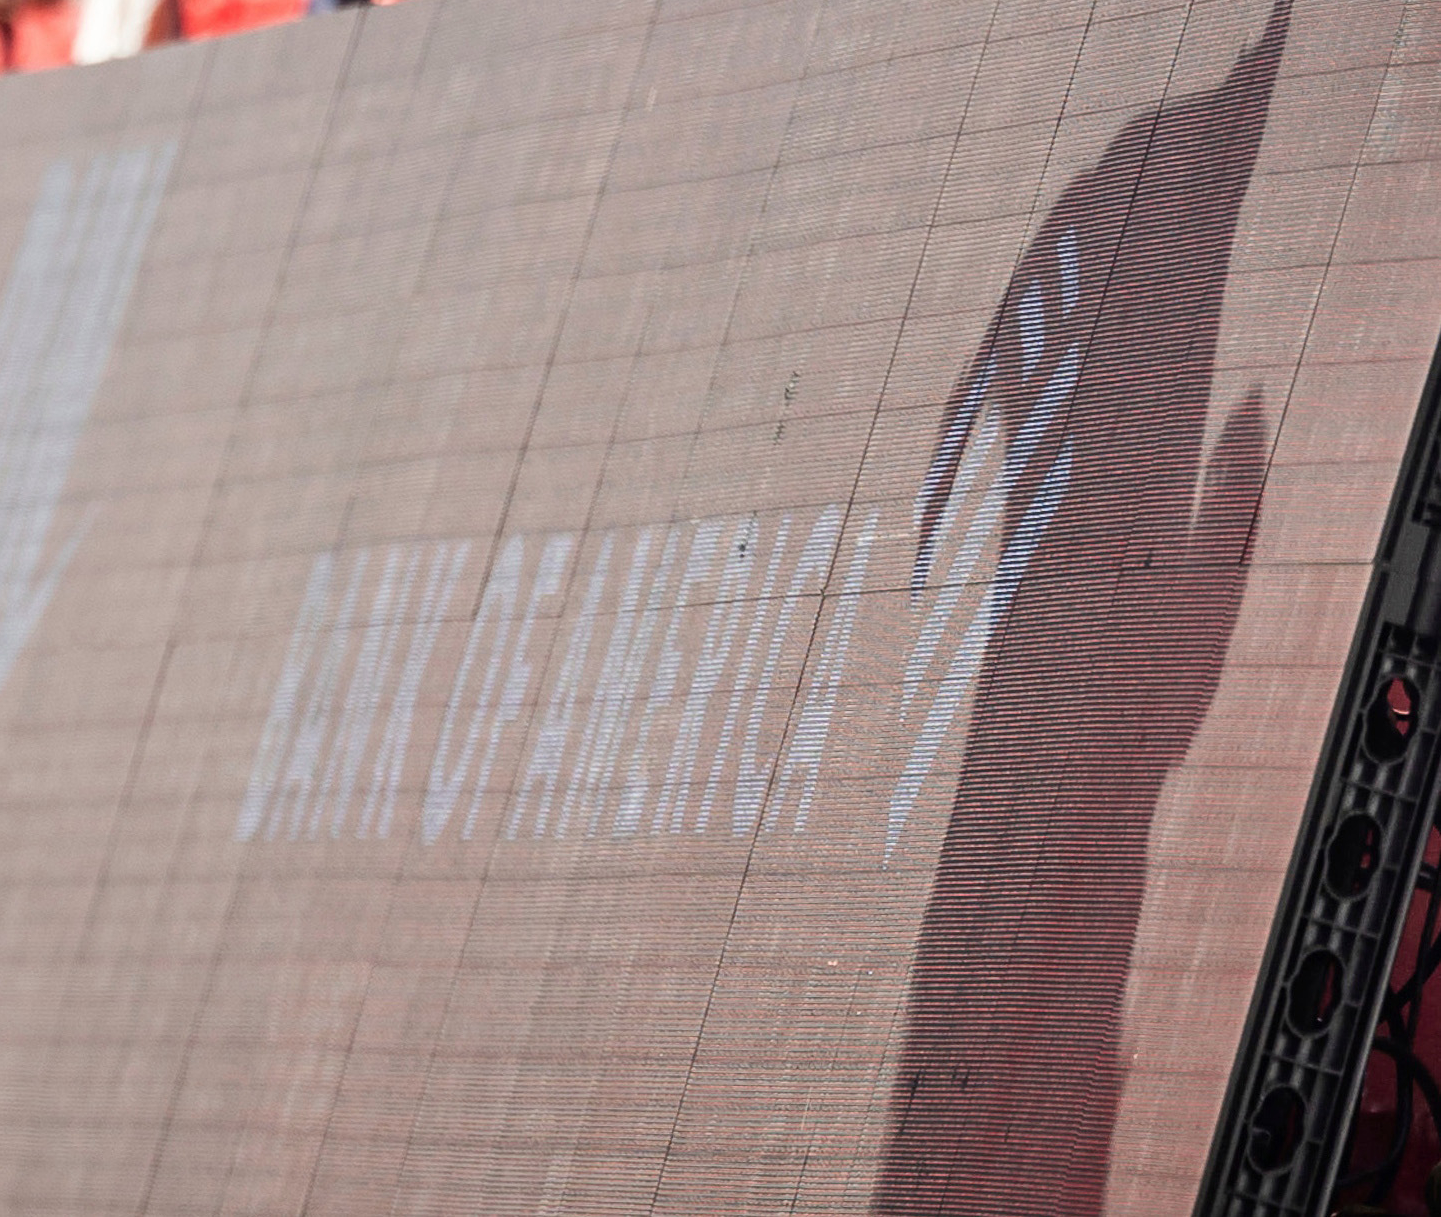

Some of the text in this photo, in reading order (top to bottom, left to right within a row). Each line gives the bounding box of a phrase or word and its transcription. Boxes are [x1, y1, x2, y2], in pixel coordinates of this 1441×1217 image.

[234, 503, 881, 846] BANK OF AMERICA
